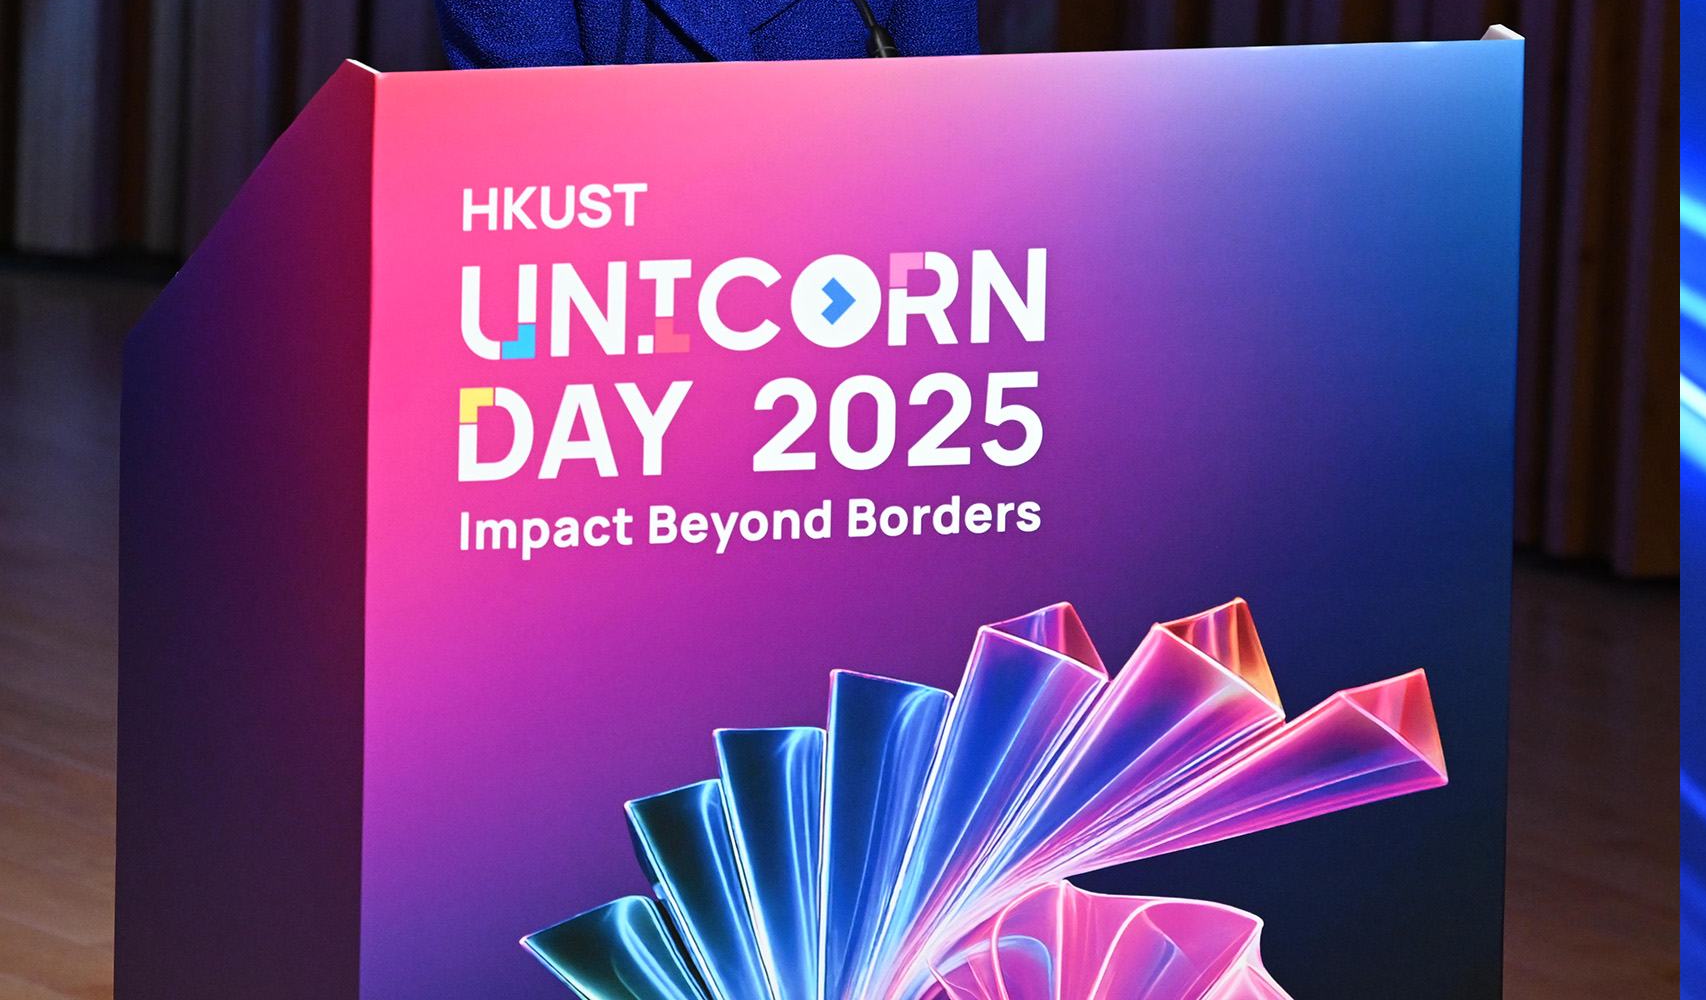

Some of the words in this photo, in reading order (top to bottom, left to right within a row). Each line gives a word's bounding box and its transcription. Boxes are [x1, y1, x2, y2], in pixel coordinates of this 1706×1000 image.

[462, 183, 648, 231] HKUST
[461, 248, 1047, 360] UNICORN
[458, 381, 693, 482] DAY
[753, 371, 1043, 472] 2025
[460, 508, 633, 561] Impact
[649, 499, 832, 554] Beyond
[848, 495, 1041, 537] Borders
